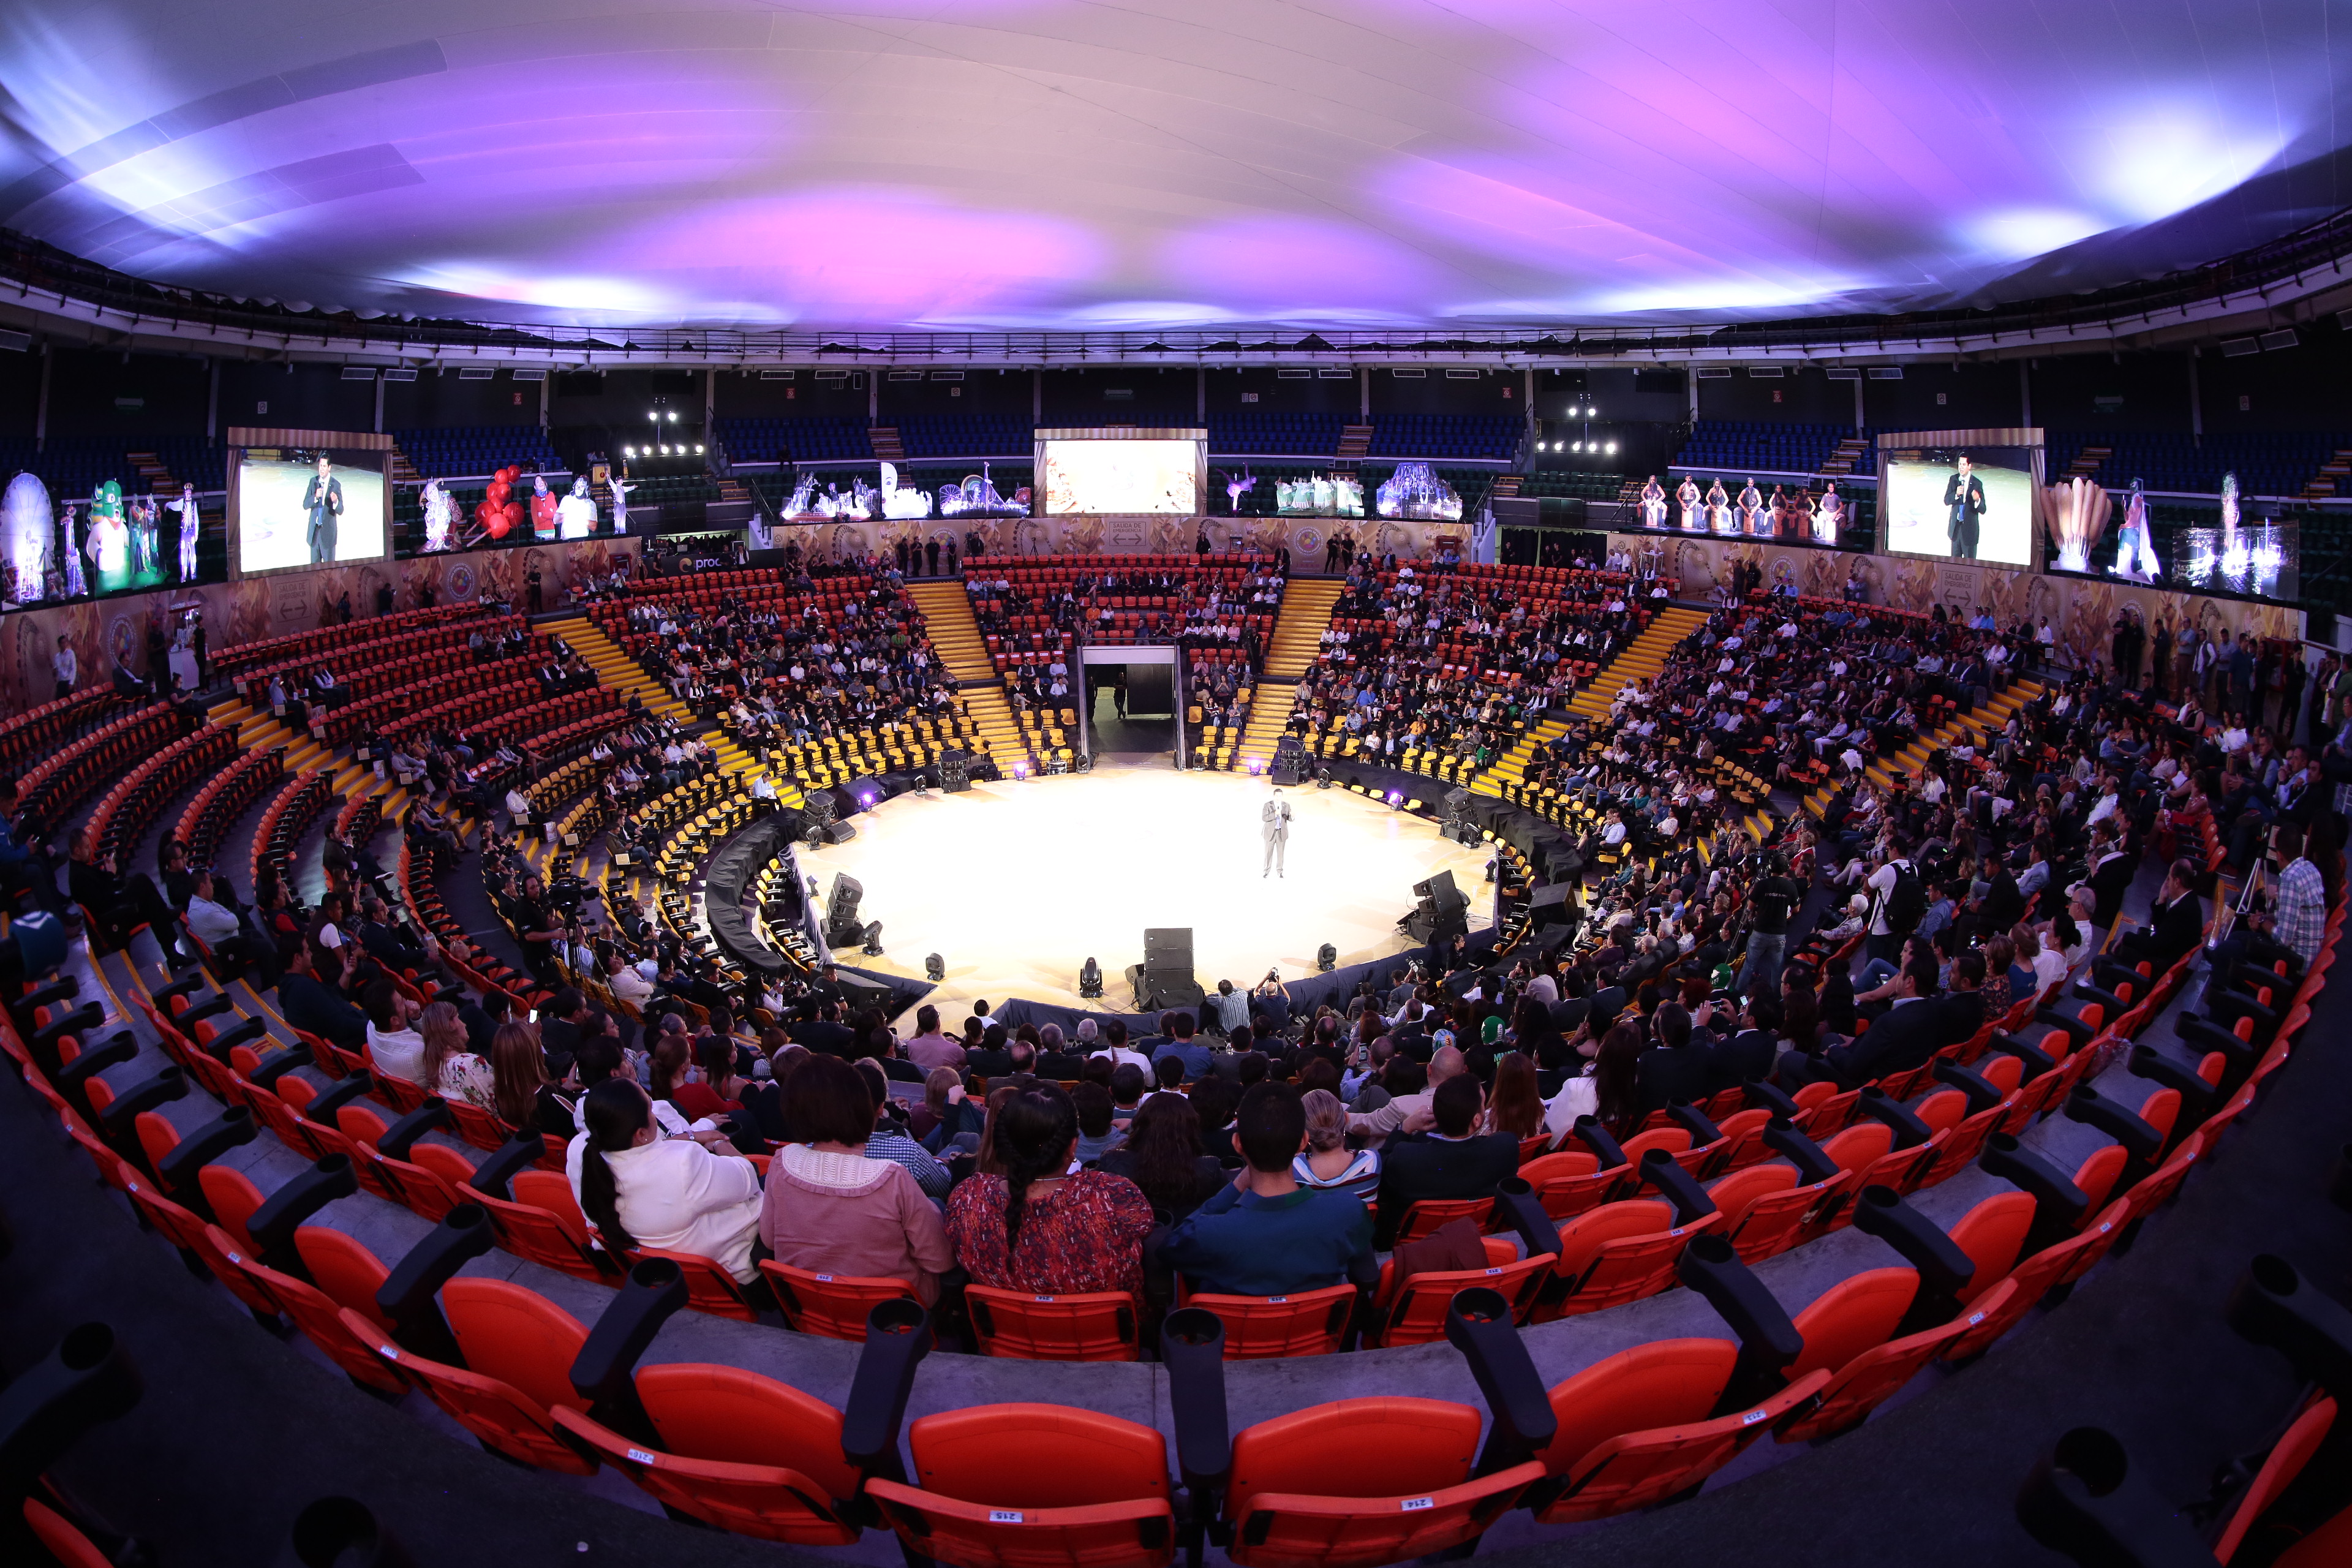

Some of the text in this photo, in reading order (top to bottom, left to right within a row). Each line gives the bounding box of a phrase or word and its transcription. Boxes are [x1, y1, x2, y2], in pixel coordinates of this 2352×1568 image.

[1945, 573, 1963, 582] SALIDA
[279, 583, 297, 593] SALIDA
[1944, 580, 1972, 589] EMERGENCIA
[1747, 1412, 1761, 1421] 213
[632, 1451, 649, 1461] 216
[1408, 1499, 1426, 1508] 214
